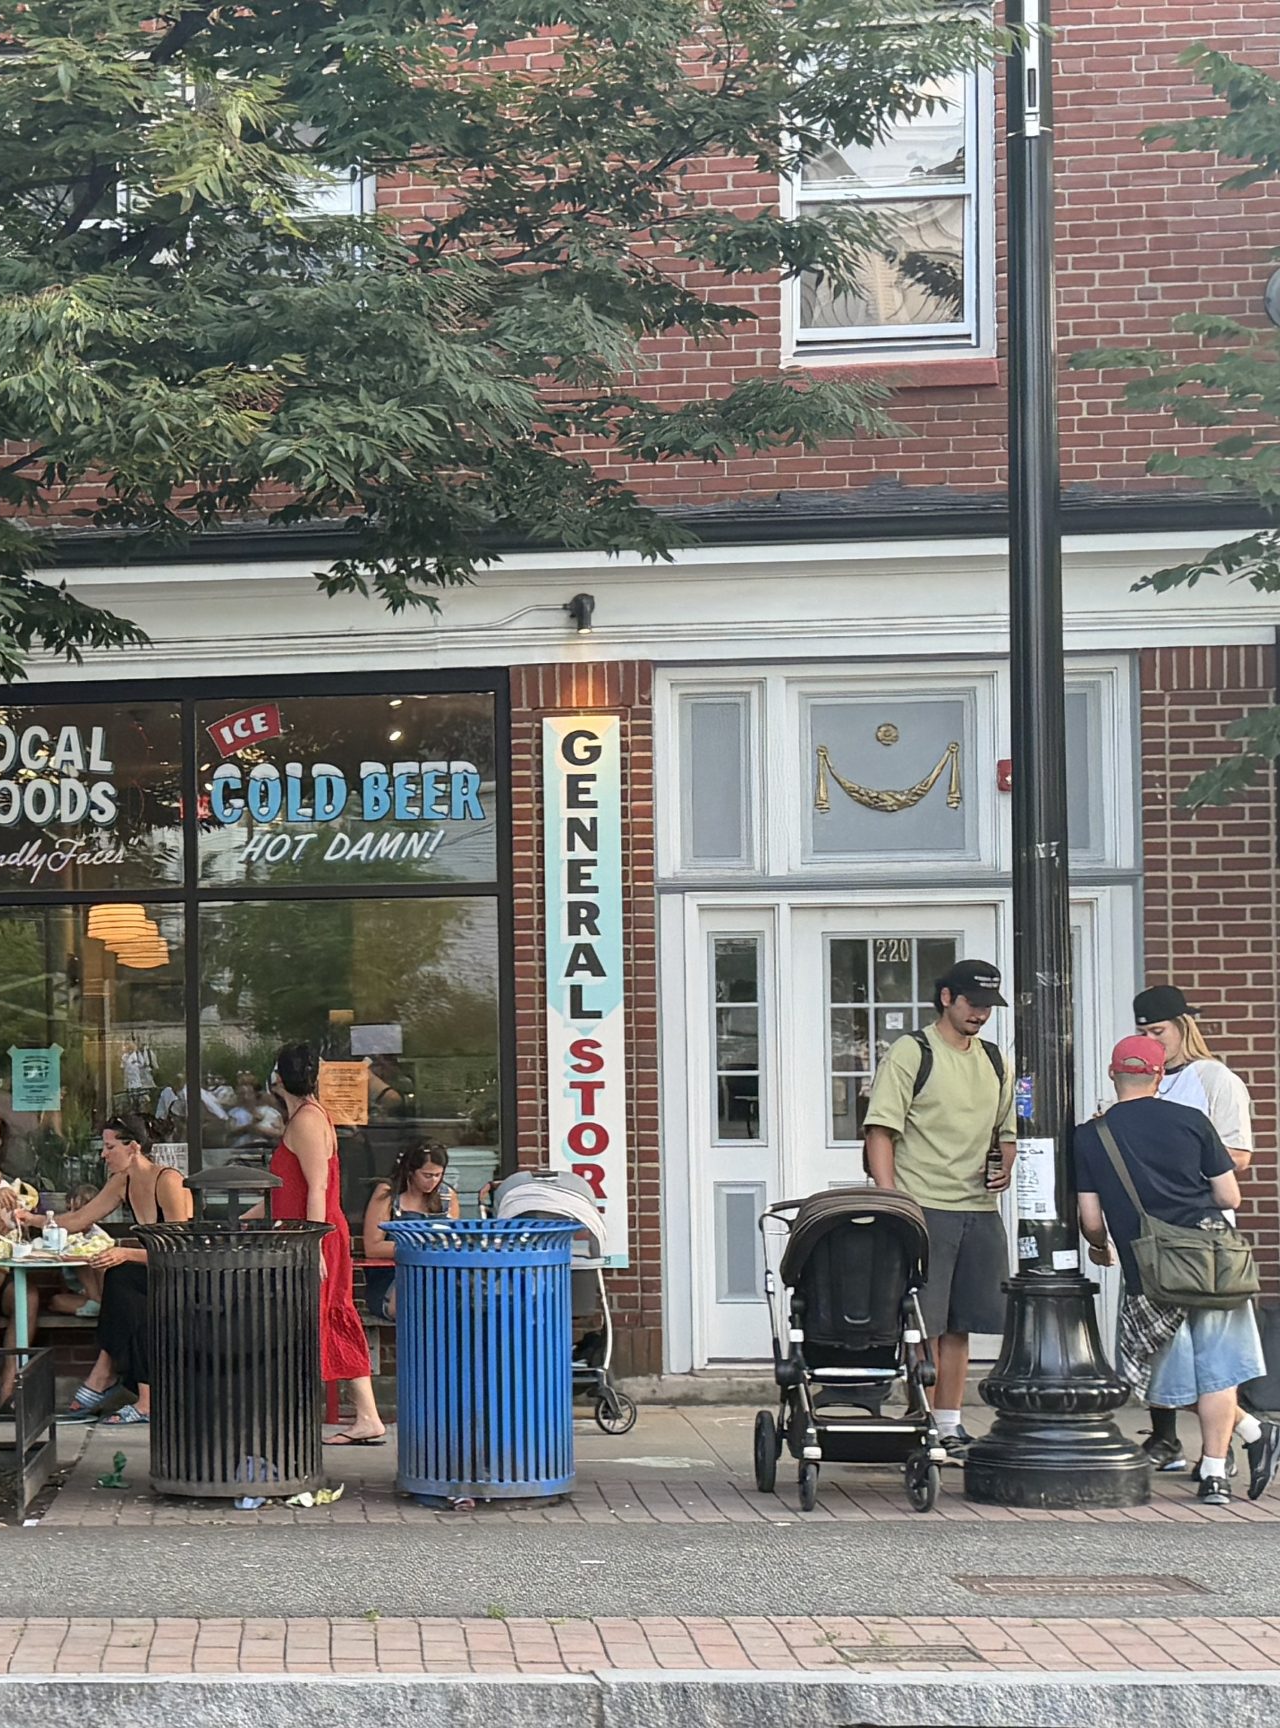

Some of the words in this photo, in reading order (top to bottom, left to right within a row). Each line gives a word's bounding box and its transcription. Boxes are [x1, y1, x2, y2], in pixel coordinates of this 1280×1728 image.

[219, 712, 270, 744] ICE
[210, 762, 348, 824] COLD
[360, 761, 486, 822] BEER
[239, 833, 318, 863] HOT
[323, 830, 445, 863] DAMN!
[561, 729, 608, 1019] GENERAL
[876, 939, 910, 962] 220
[567, 1038, 611, 1214] STOR
